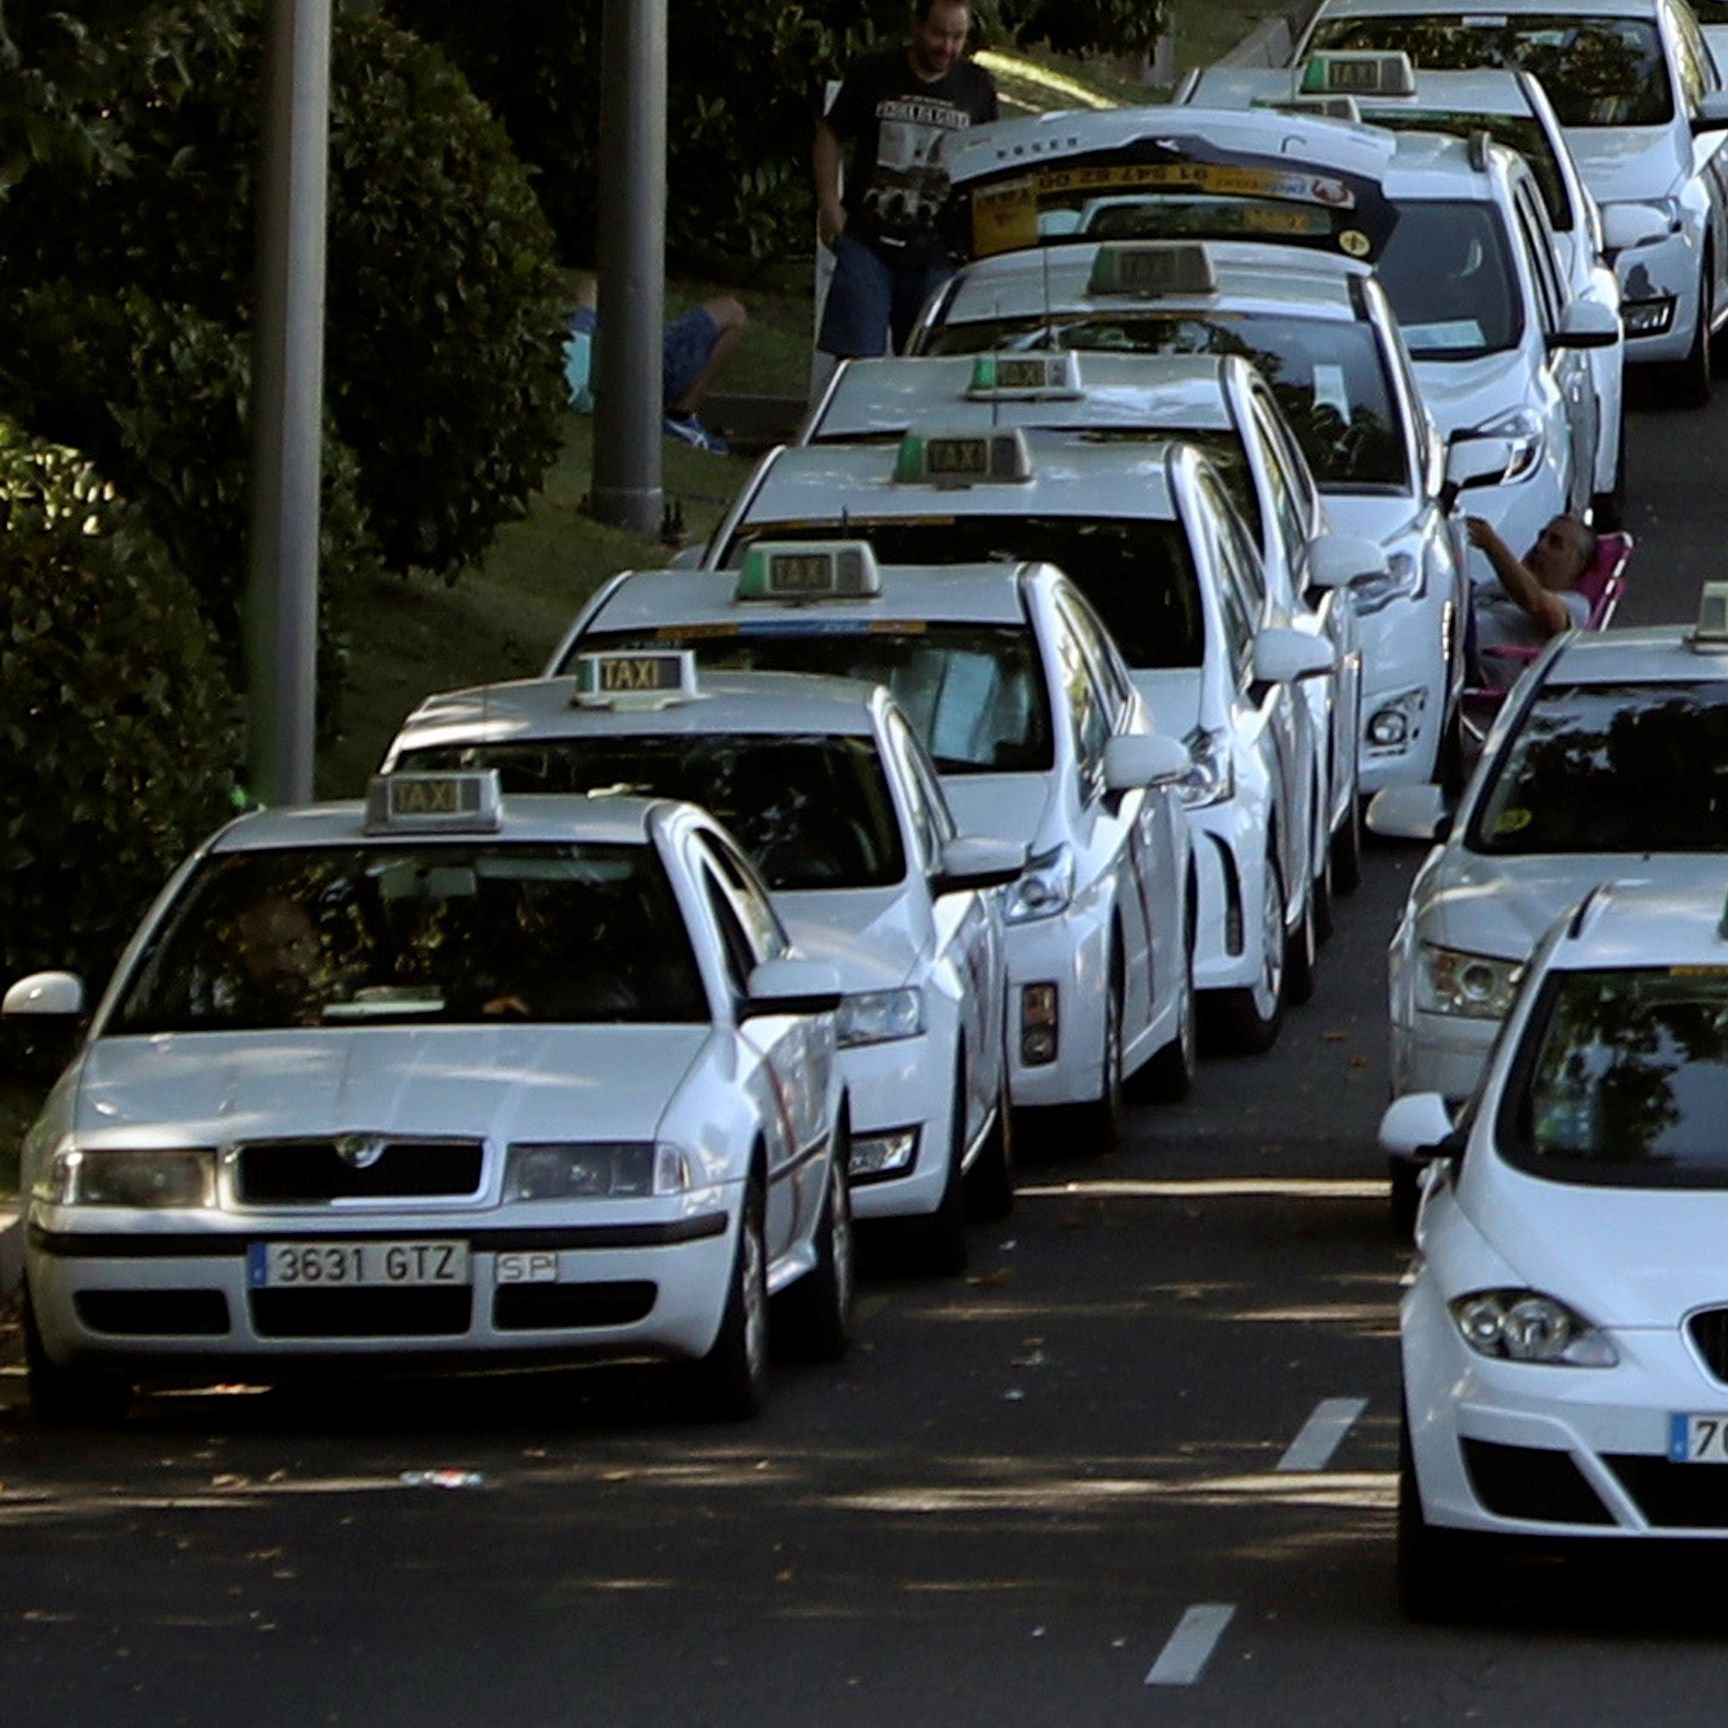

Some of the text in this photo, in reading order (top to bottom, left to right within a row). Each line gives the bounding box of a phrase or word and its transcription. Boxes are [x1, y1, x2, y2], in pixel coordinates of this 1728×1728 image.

[602, 658, 659, 689] TAXI
[397, 782, 455, 811] TAXI
[279, 1243, 454, 1282] 3631 GTZ
[501, 1257, 554, 1281] SP
